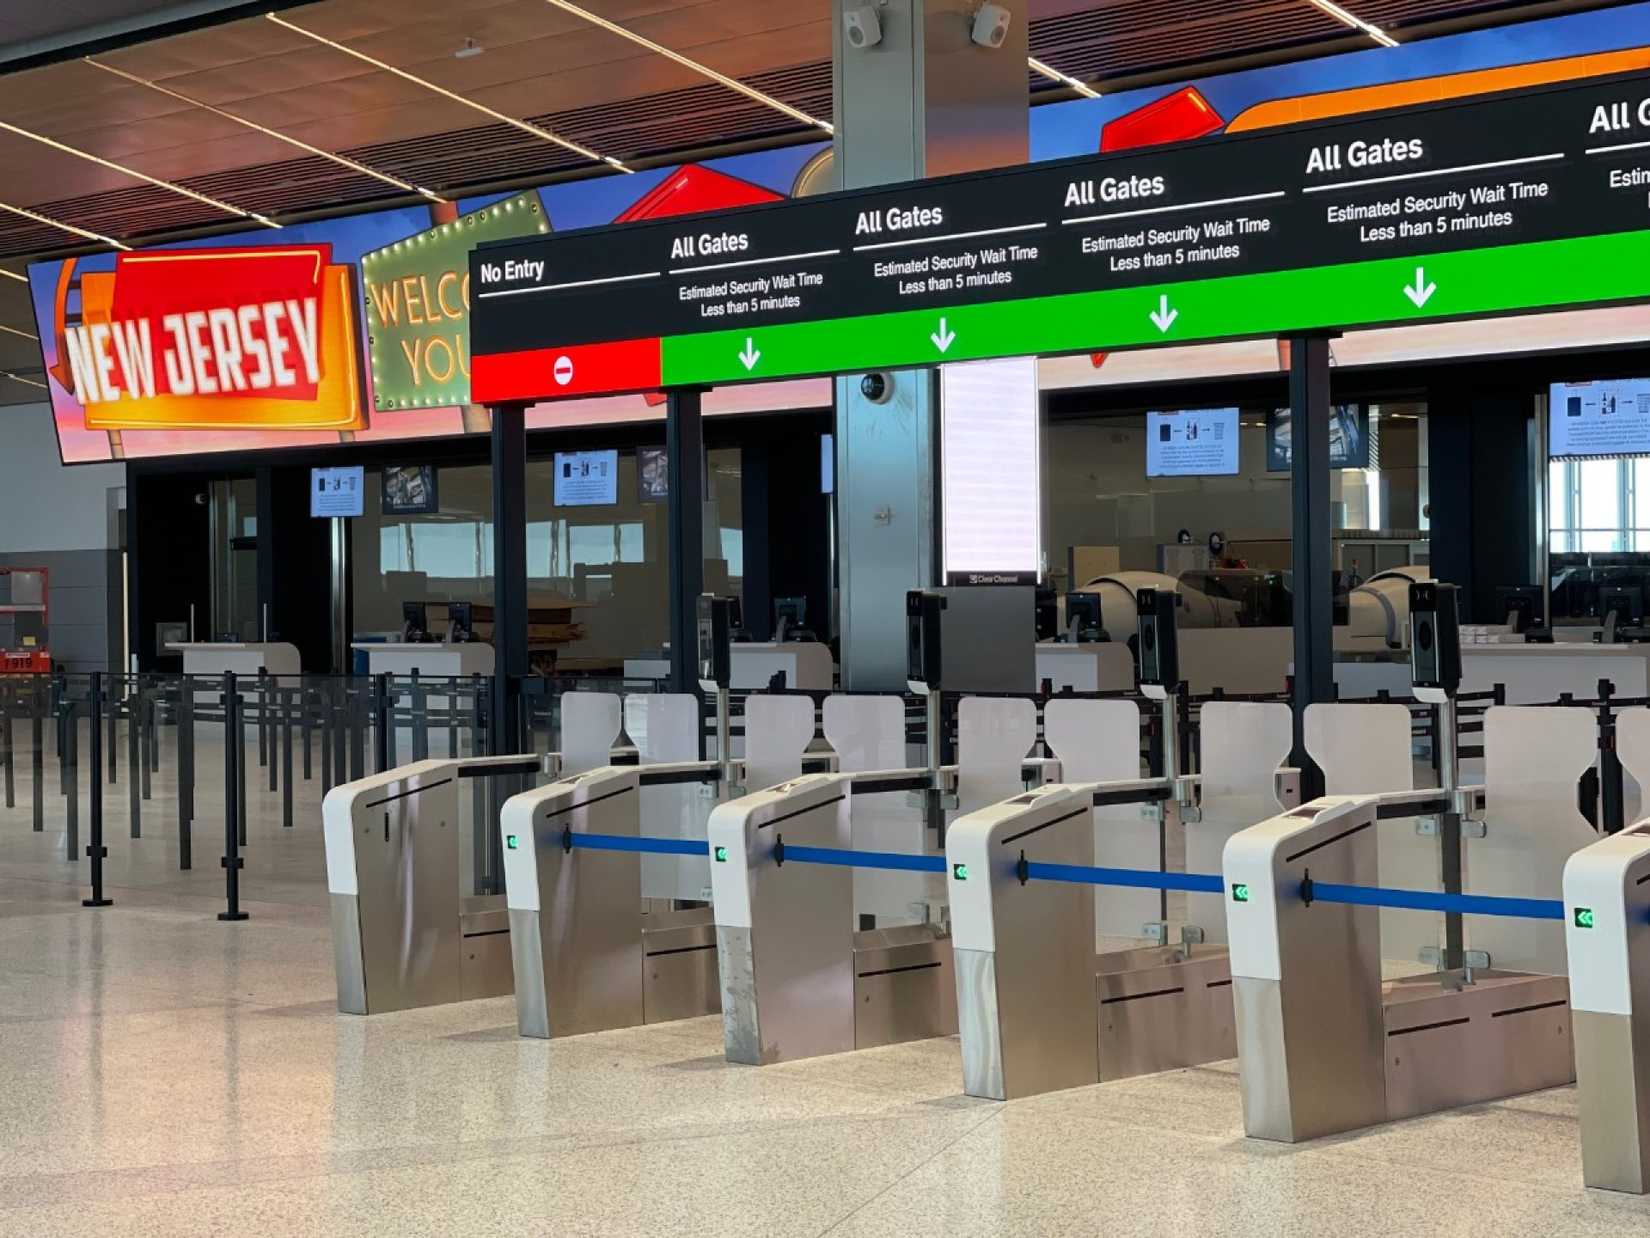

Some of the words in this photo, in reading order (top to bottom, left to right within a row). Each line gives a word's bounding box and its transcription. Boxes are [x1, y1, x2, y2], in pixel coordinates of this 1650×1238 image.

[1588, 101, 1631, 134] All
[1305, 144, 1342, 174] All
[1347, 137, 1424, 168] Gates
[1064, 180, 1097, 208] All
[1099, 175, 1166, 203] Gates
[1327, 197, 1401, 223] Estimated
[1403, 190, 1467, 214] Security
[1469, 184, 1506, 205] Wait
[1508, 181, 1550, 200] Time
[855, 205, 882, 236] All
[885, 205, 944, 231] Gates
[1081, 230, 1145, 254] Estimated
[1147, 224, 1201, 246] Security
[1203, 219, 1234, 239] Wait
[1235, 217, 1272, 234] Time
[1360, 225, 1396, 243] Less
[1398, 220, 1433, 238] than
[1436, 216, 1448, 234] 5
[1450, 211, 1513, 232] minutes
[670, 236, 695, 260] All
[697, 231, 749, 256] Gates
[873, 256, 929, 278] Estimated
[930, 251, 978, 272] Security
[979, 247, 1007, 265] Wait
[1007, 245, 1039, 261] Time
[1110, 255, 1142, 272] Less
[1142, 251, 1173, 268] than
[1175, 248, 1185, 265] 5
[1187, 244, 1241, 263] minutes
[480, 263, 502, 284] No
[504, 259, 545, 282] Entry
[679, 281, 728, 301] Estimated
[729, 277, 771, 295] Security
[771, 274, 796, 290] Wait
[796, 271, 824, 287] Time
[899, 280, 926, 295] Less
[927, 276, 954, 292] than
[955, 273, 964, 289] 5
[966, 269, 1013, 287] minutes
[370, 271, 470, 330] WELC
[700, 303, 726, 317] Less
[726, 299, 749, 314] than
[750, 297, 759, 312] 5
[759, 294, 801, 311] minutes
[65, 318, 156, 405] NEW
[162, 297, 320, 396] JERSEY
